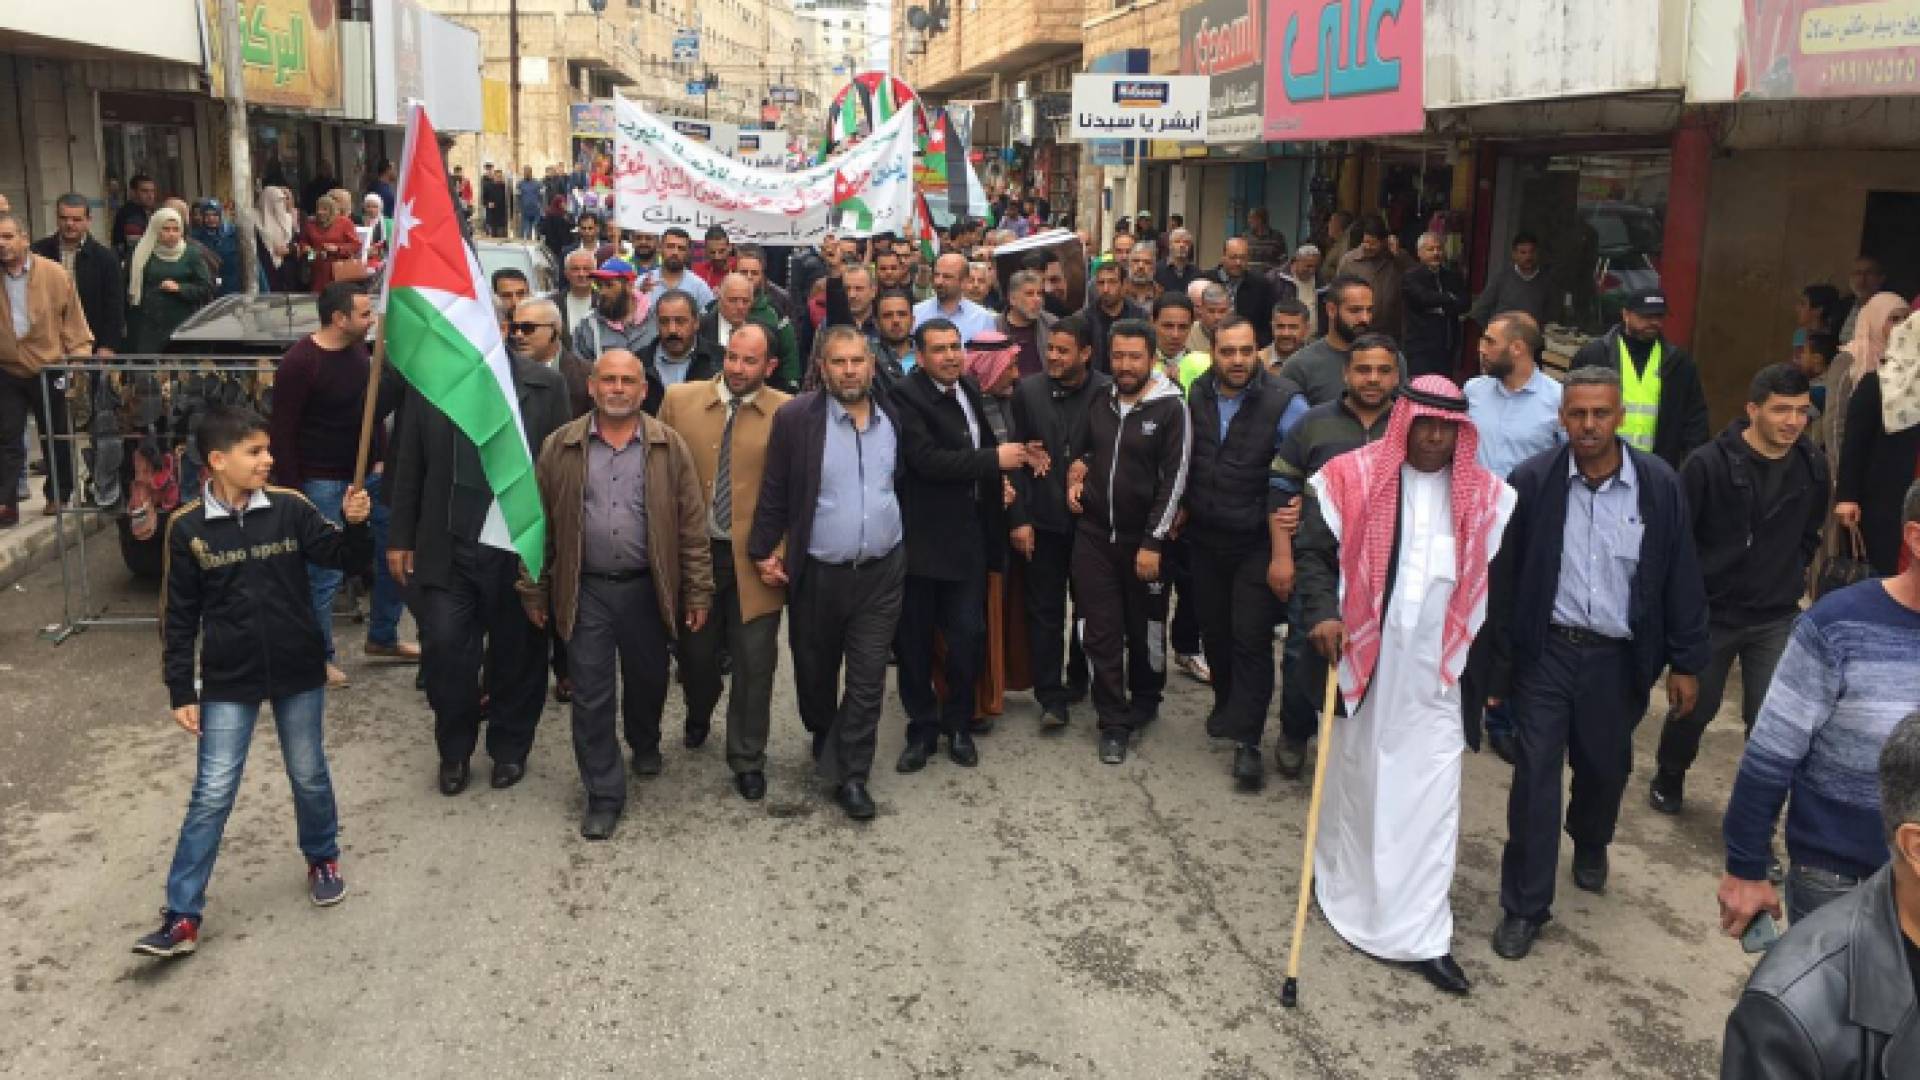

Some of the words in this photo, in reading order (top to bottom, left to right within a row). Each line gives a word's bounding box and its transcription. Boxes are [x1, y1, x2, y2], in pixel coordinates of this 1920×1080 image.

[1079, 112, 1135, 132] سيدنا
[1139, 112, 1154, 132] يا
[1158, 110, 1200, 132] أبشر
